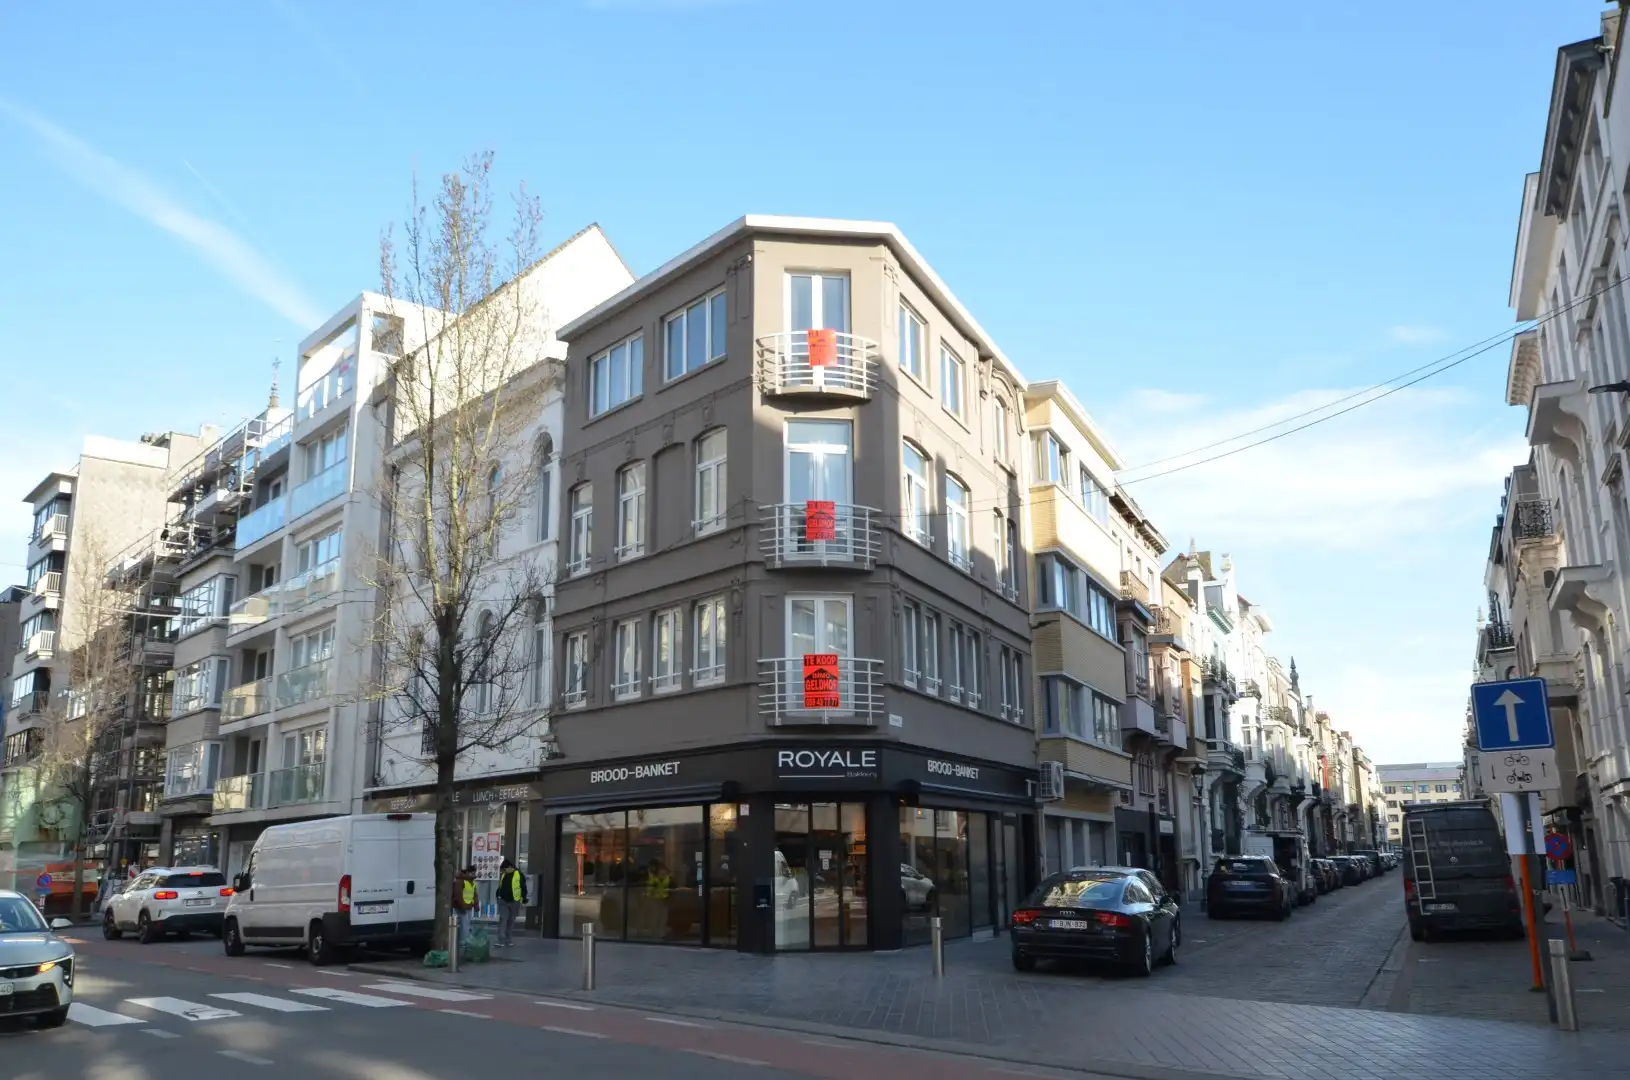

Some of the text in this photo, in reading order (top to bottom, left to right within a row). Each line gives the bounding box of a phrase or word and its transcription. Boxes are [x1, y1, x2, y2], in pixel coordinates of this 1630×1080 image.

[805, 655, 837, 665] TE KOOP
[778, 750, 877, 767] ROYALE
[590, 761, 680, 783] BROOD-BANKET
[927, 759, 979, 780] BROOD-BANKET
